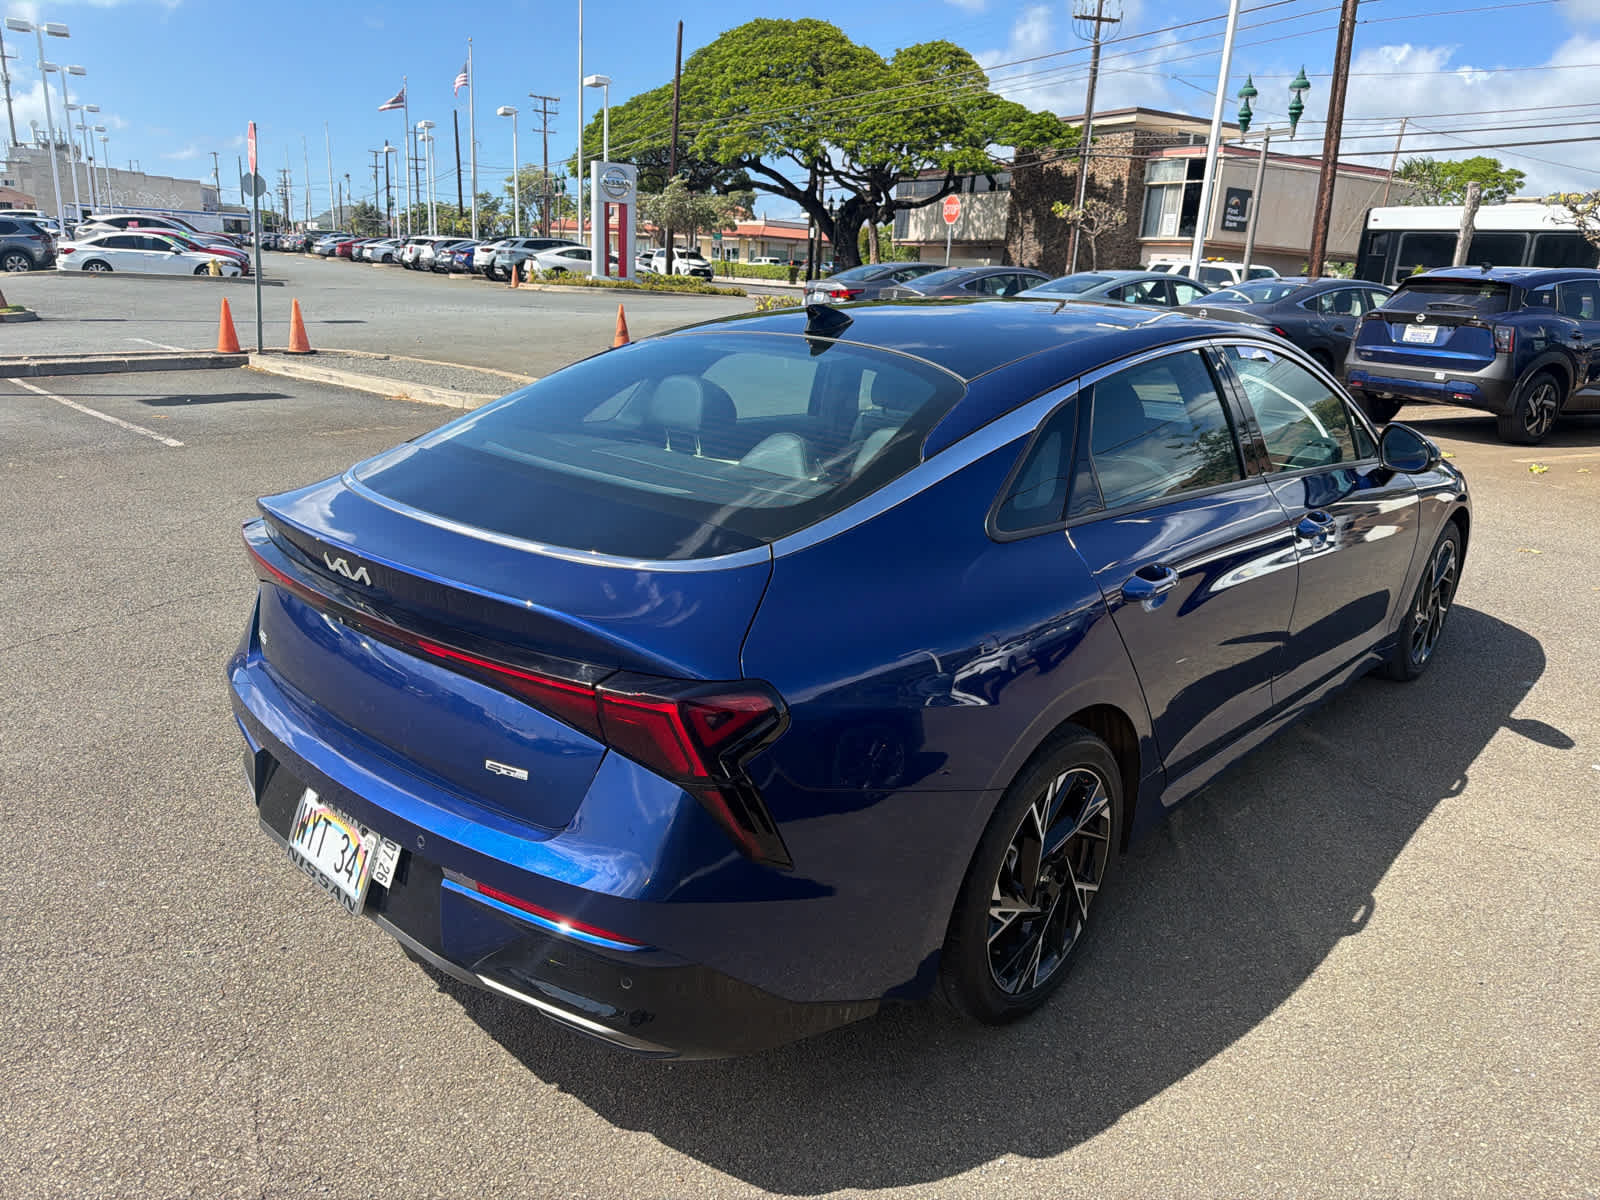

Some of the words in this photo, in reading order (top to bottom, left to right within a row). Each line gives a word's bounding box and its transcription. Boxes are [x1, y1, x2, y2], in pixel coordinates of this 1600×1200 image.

[603, 179, 631, 187] NISSAN
[944, 204, 959, 214] STOP
[294, 803, 331, 858] WYT
[334, 834, 368, 889] 341
[384, 841, 397, 861] 07
[288, 847, 356, 912] NISSAN
[376, 864, 392, 883] 26
